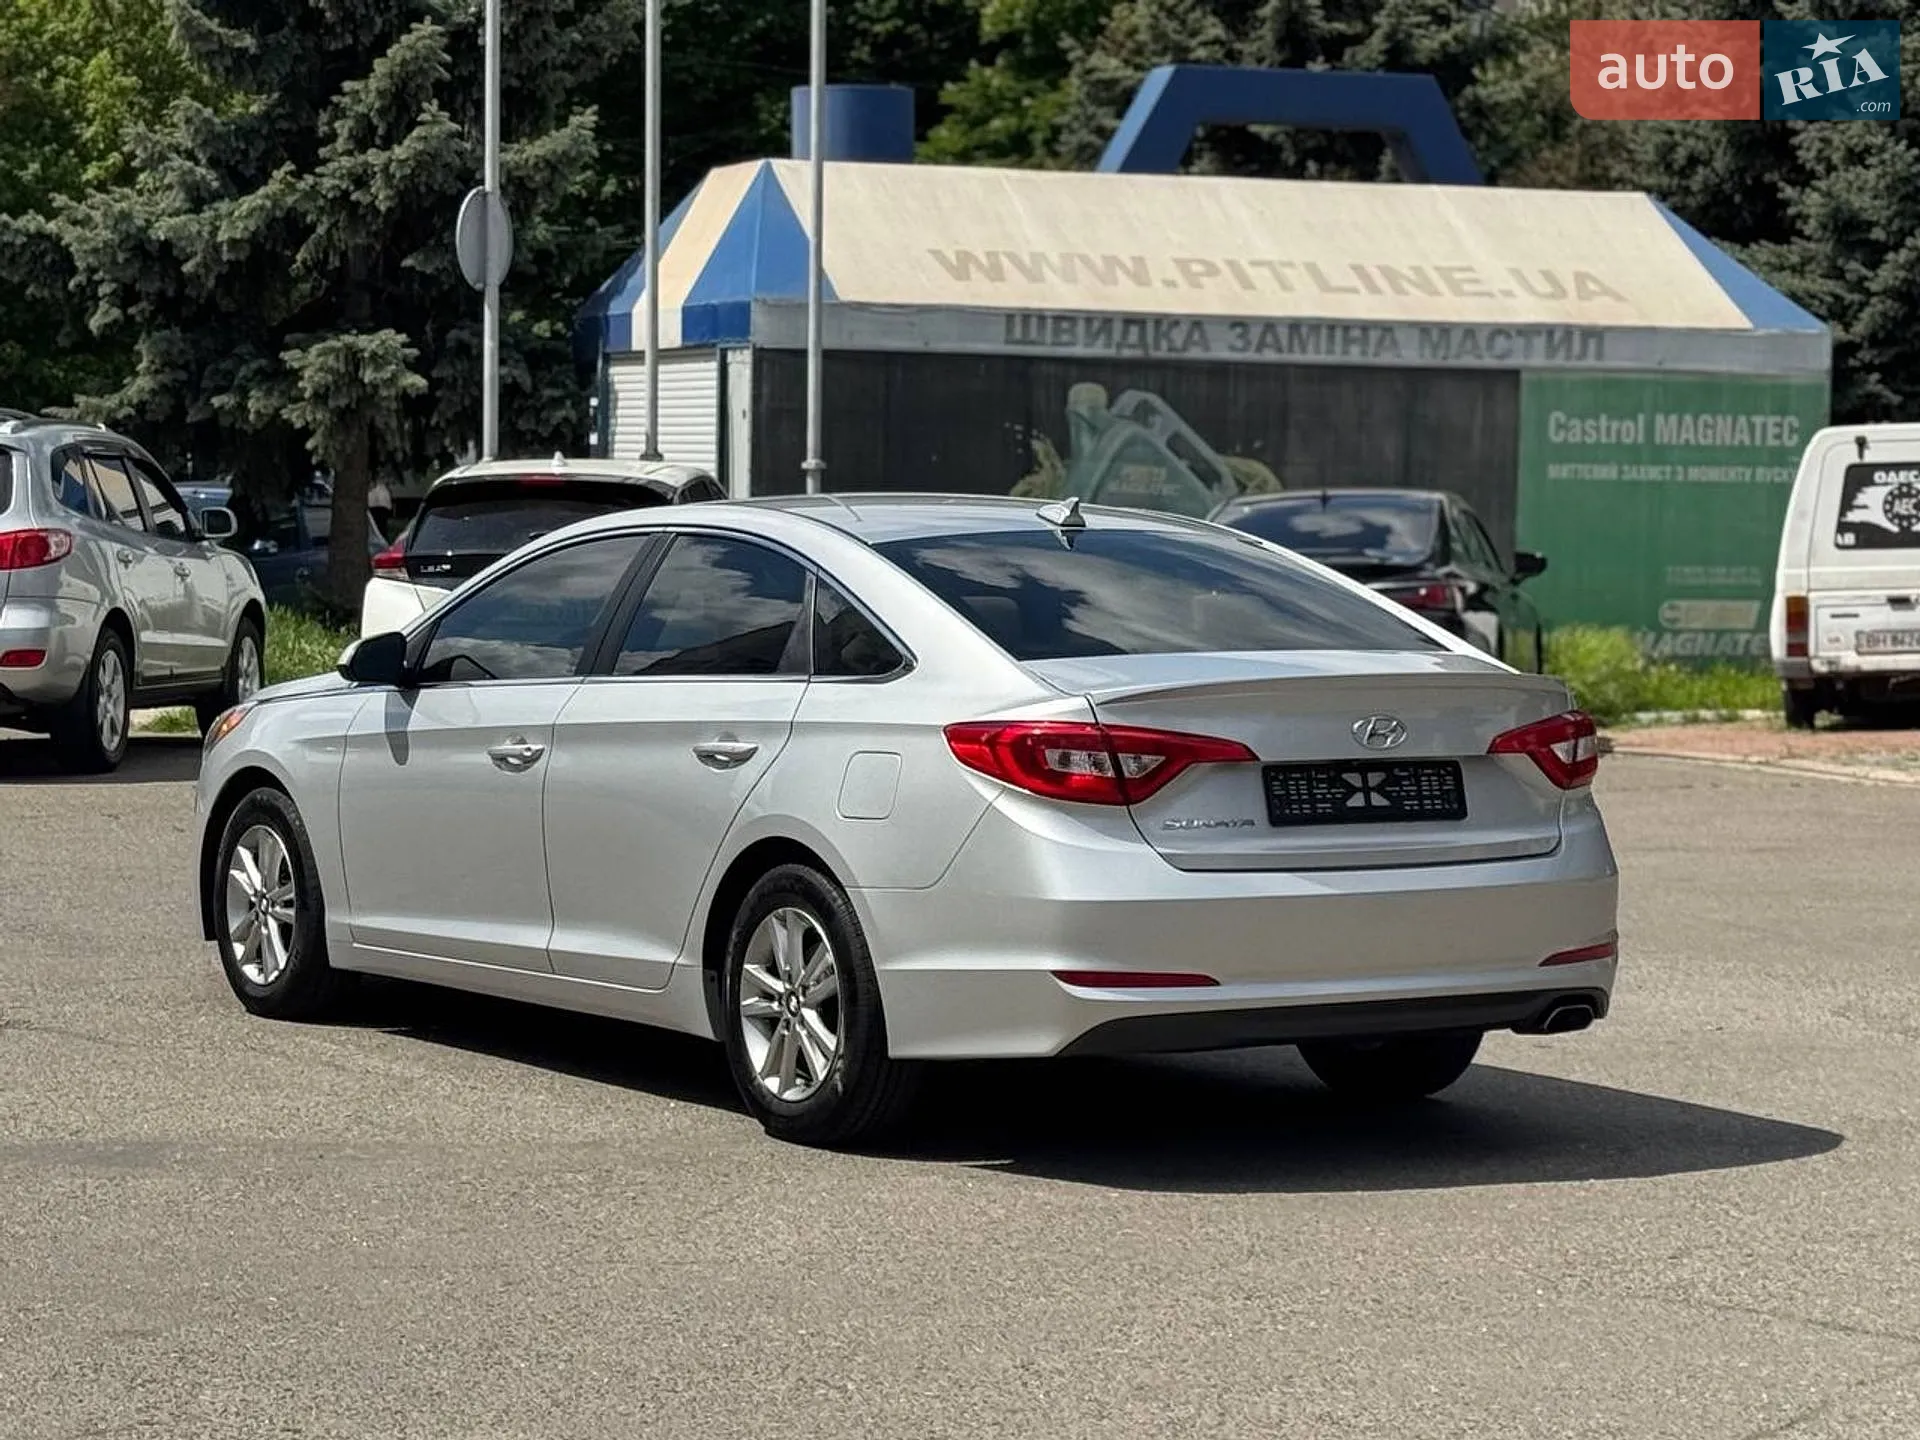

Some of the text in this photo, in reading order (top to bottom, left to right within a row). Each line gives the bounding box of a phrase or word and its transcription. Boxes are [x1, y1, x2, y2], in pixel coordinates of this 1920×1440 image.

[926, 247, 1630, 302] WWW.PITLINE.UA
[1004, 312, 1606, 362] ШВИДКА ЗАМІНА МАСТИЛ
[1547, 410, 1800, 447] Castrol MAGNATEC
